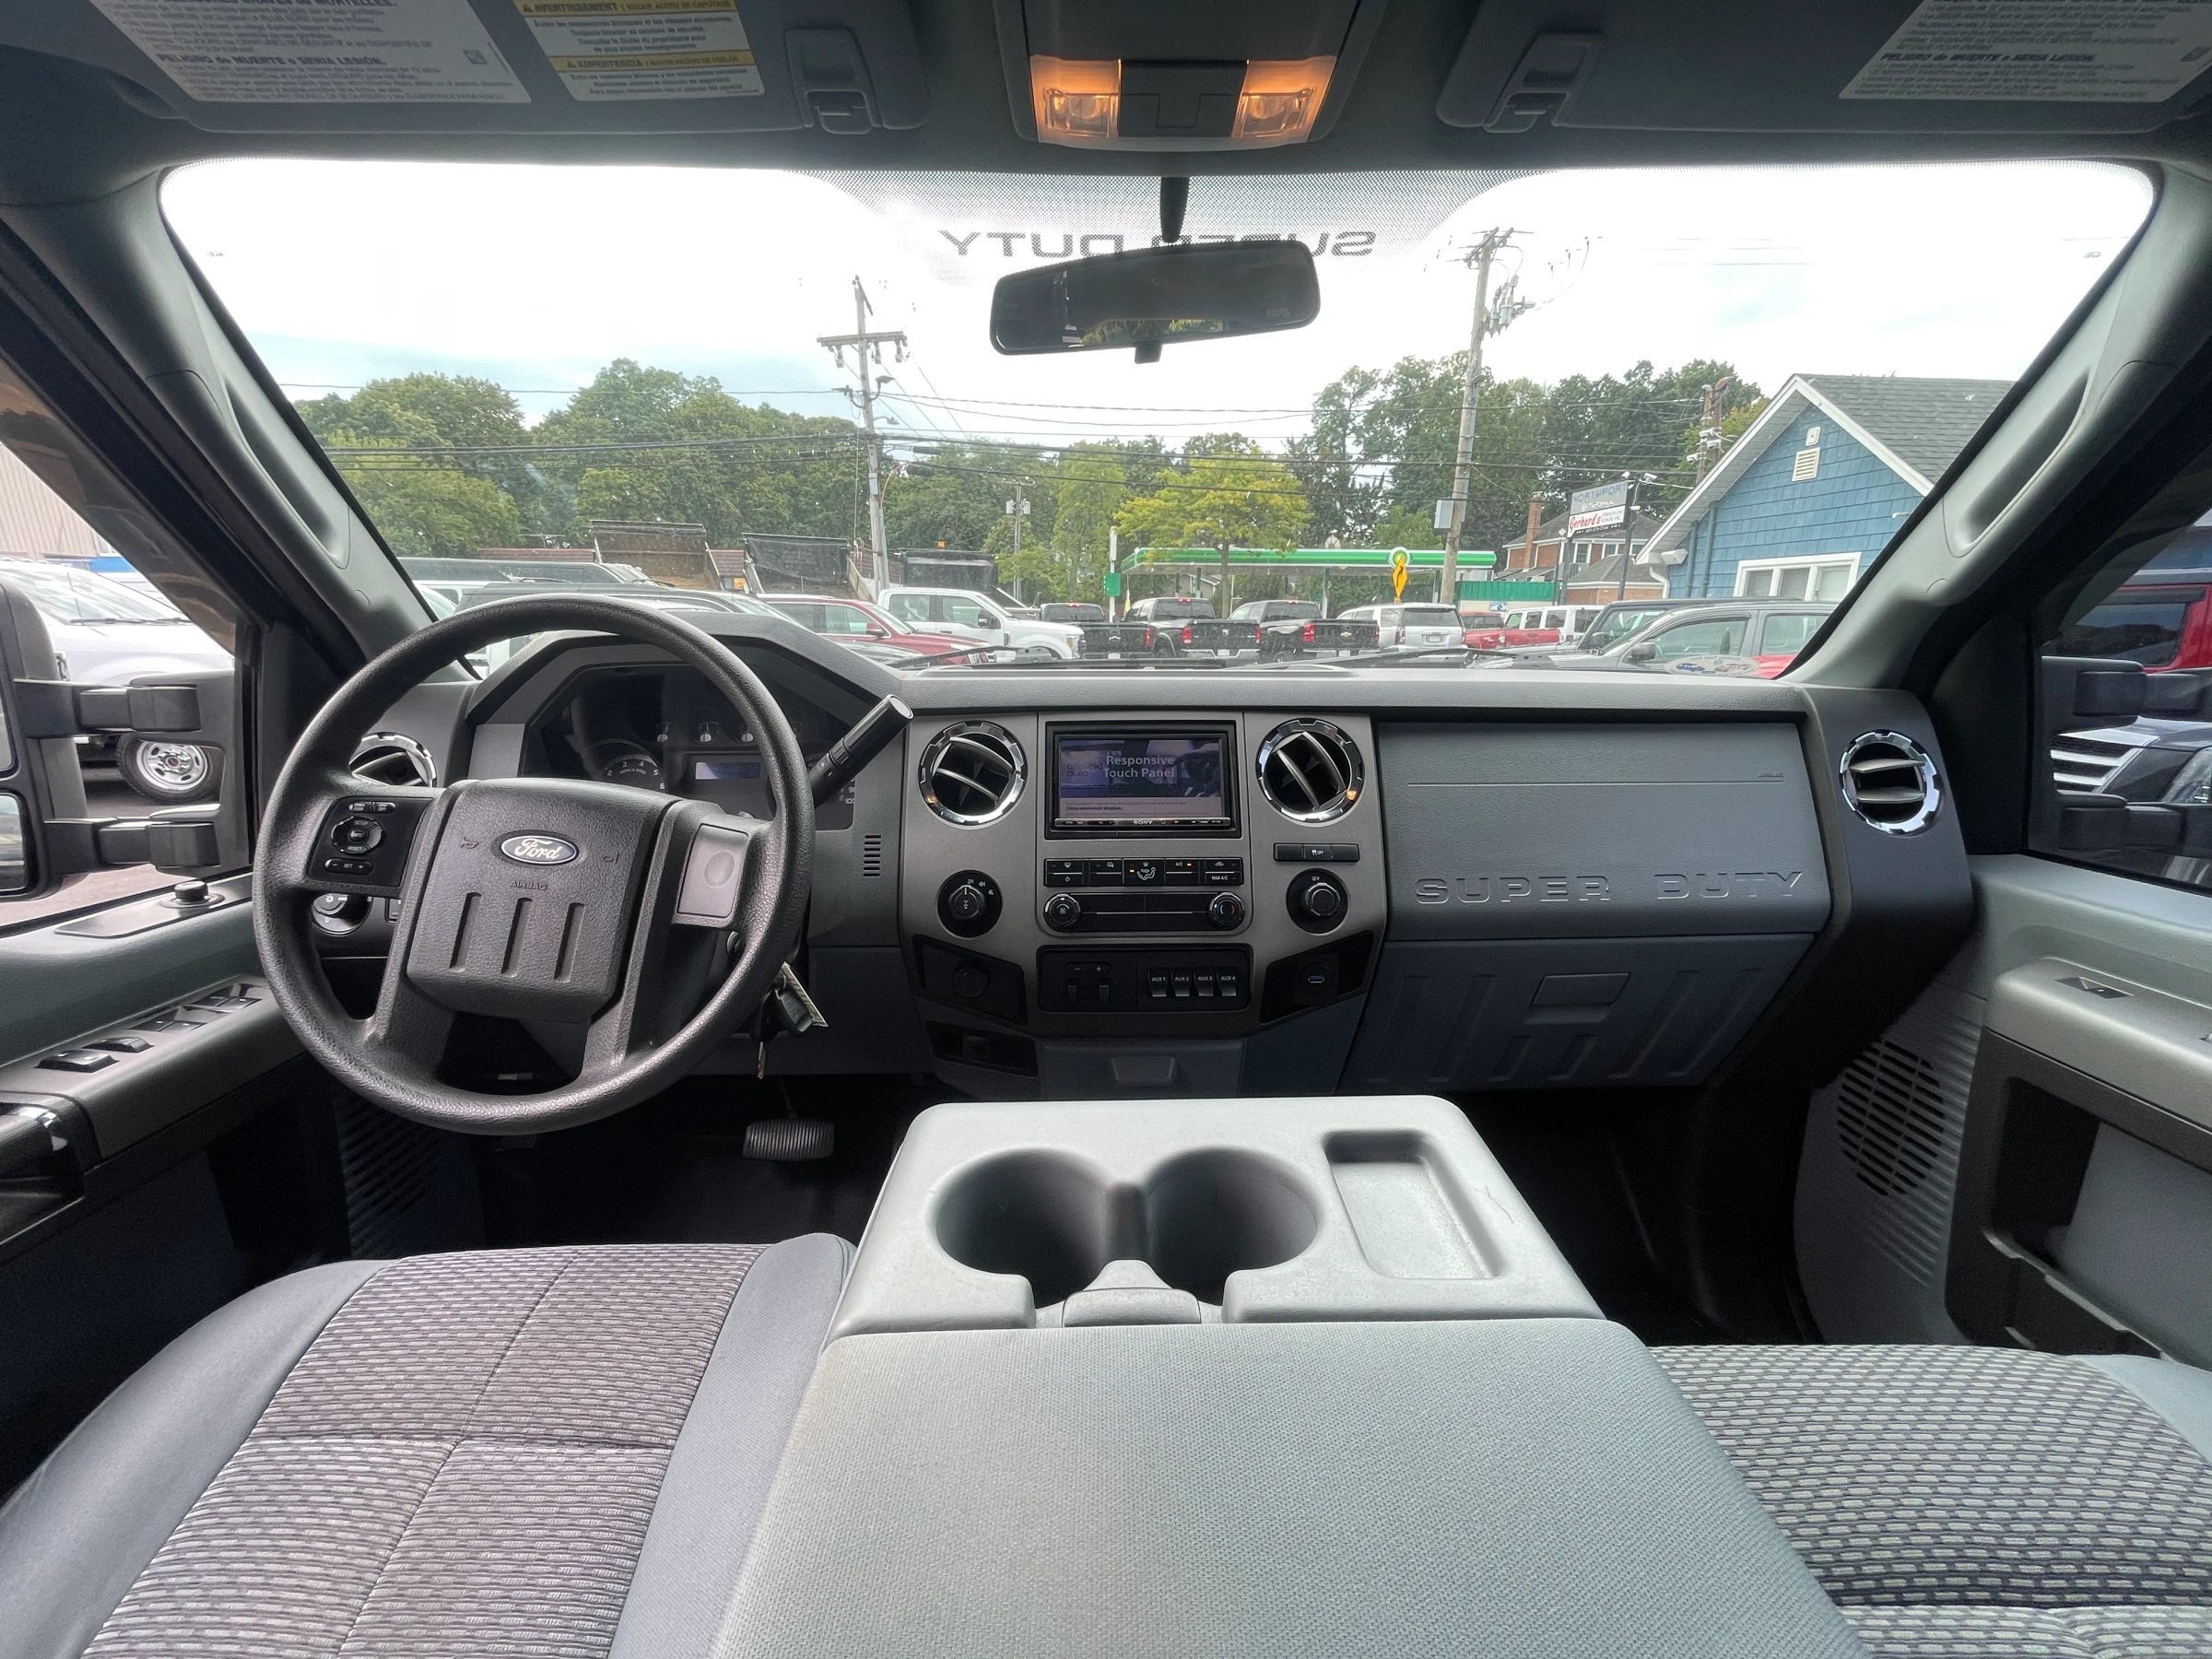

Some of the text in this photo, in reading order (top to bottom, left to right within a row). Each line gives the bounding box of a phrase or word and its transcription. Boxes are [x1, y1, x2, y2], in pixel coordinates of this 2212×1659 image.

[232, 56, 286, 65] MUERTE
[1106, 755, 1176, 768] Responsive
[1104, 768, 1176, 779] Touch Panel
[514, 838, 563, 859] Ford
[1415, 871, 1803, 904] SUPER DUTY
